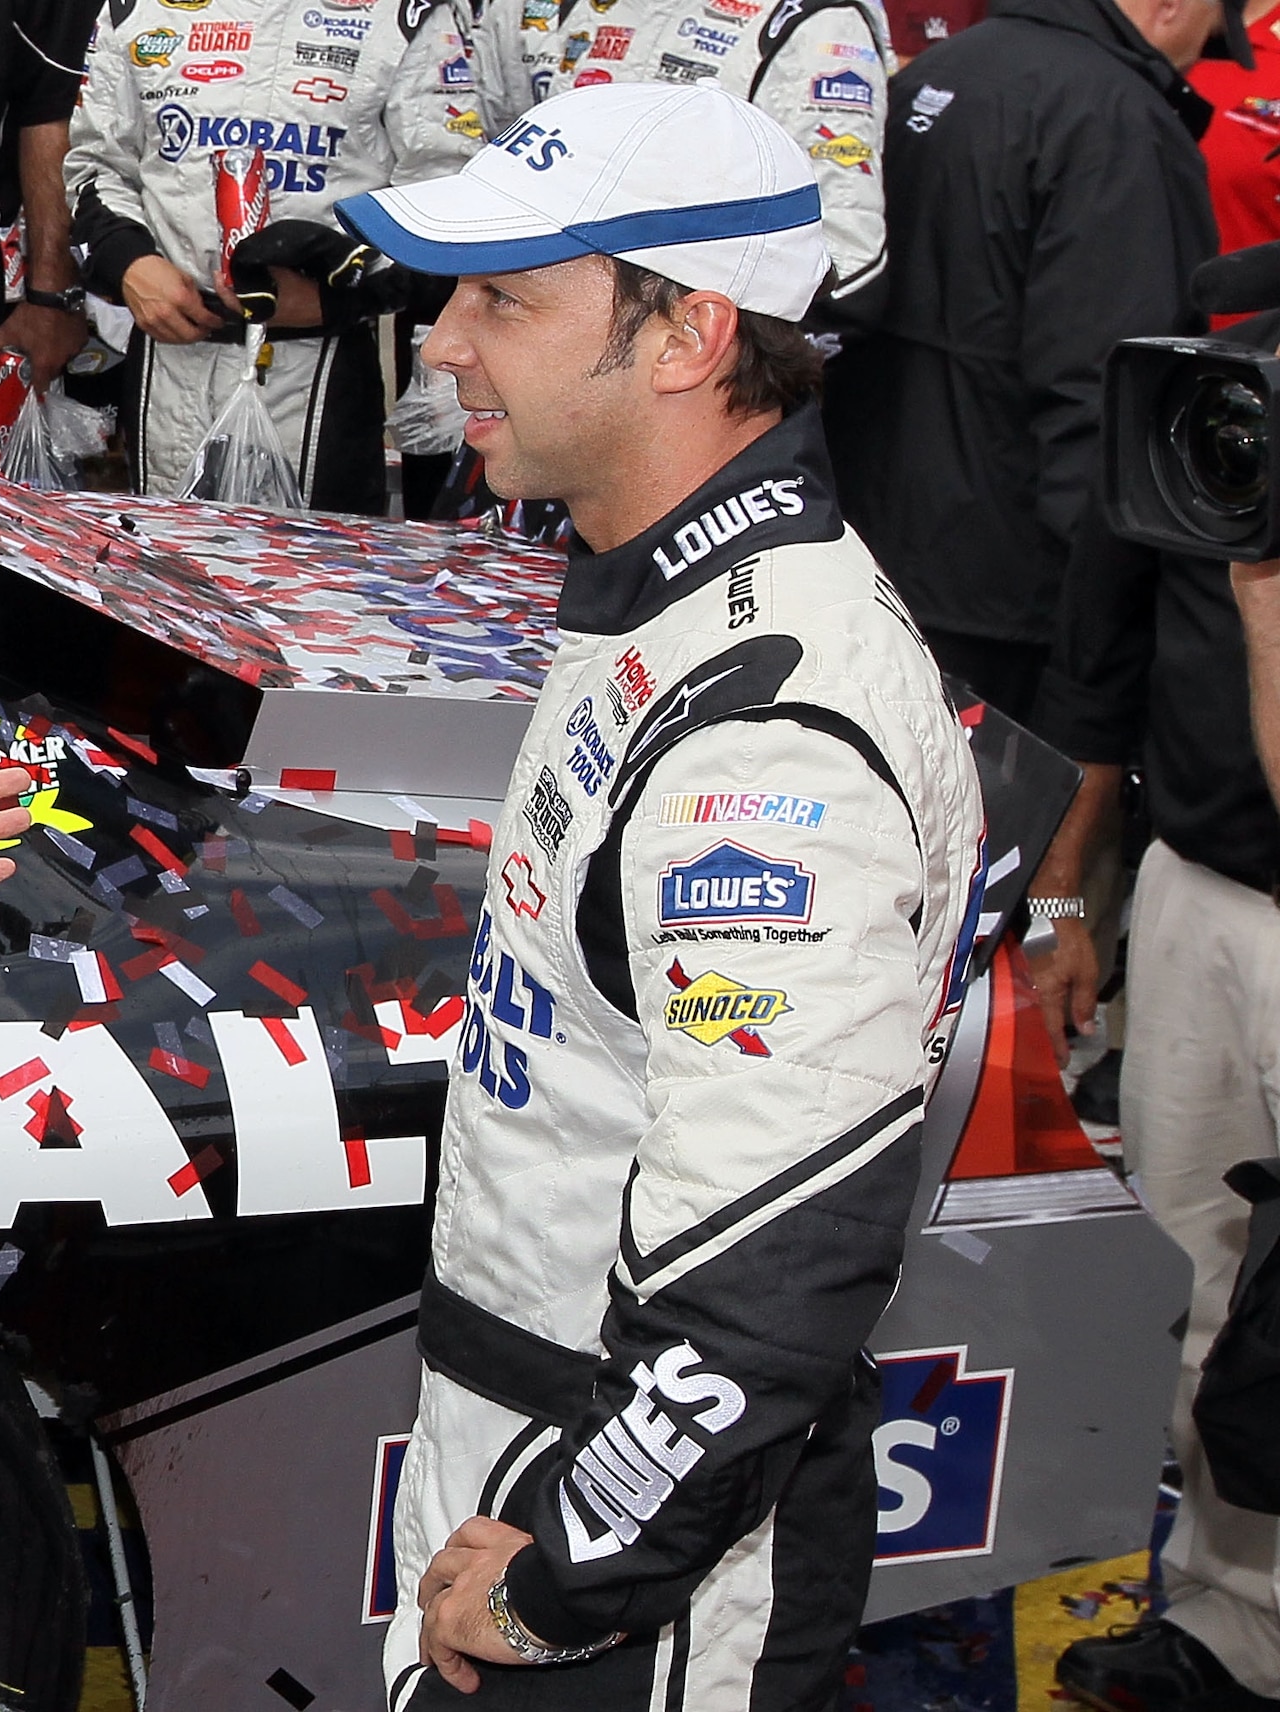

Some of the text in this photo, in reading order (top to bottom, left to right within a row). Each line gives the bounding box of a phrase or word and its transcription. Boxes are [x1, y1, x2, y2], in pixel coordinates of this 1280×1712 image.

[323, 17, 373, 30] KOBALT
[326, 28, 364, 40] TOOLS
[187, 31, 251, 52] GUARD
[186, 66, 238, 76] DELPHI
[198, 117, 348, 157] KOBALT
[651, 479, 805, 581] LOWE'S
[579, 717, 617, 780] KOBALT
[566, 743, 602, 798] TOOLS
[710, 795, 810, 824] NASCAR
[674, 870, 790, 911] LOWE'S
[696, 925, 761, 943] Something
[763, 926, 828, 944] Together
[667, 990, 774, 1024] SUNOCO
[558, 1339, 747, 1565] LOWE'S
